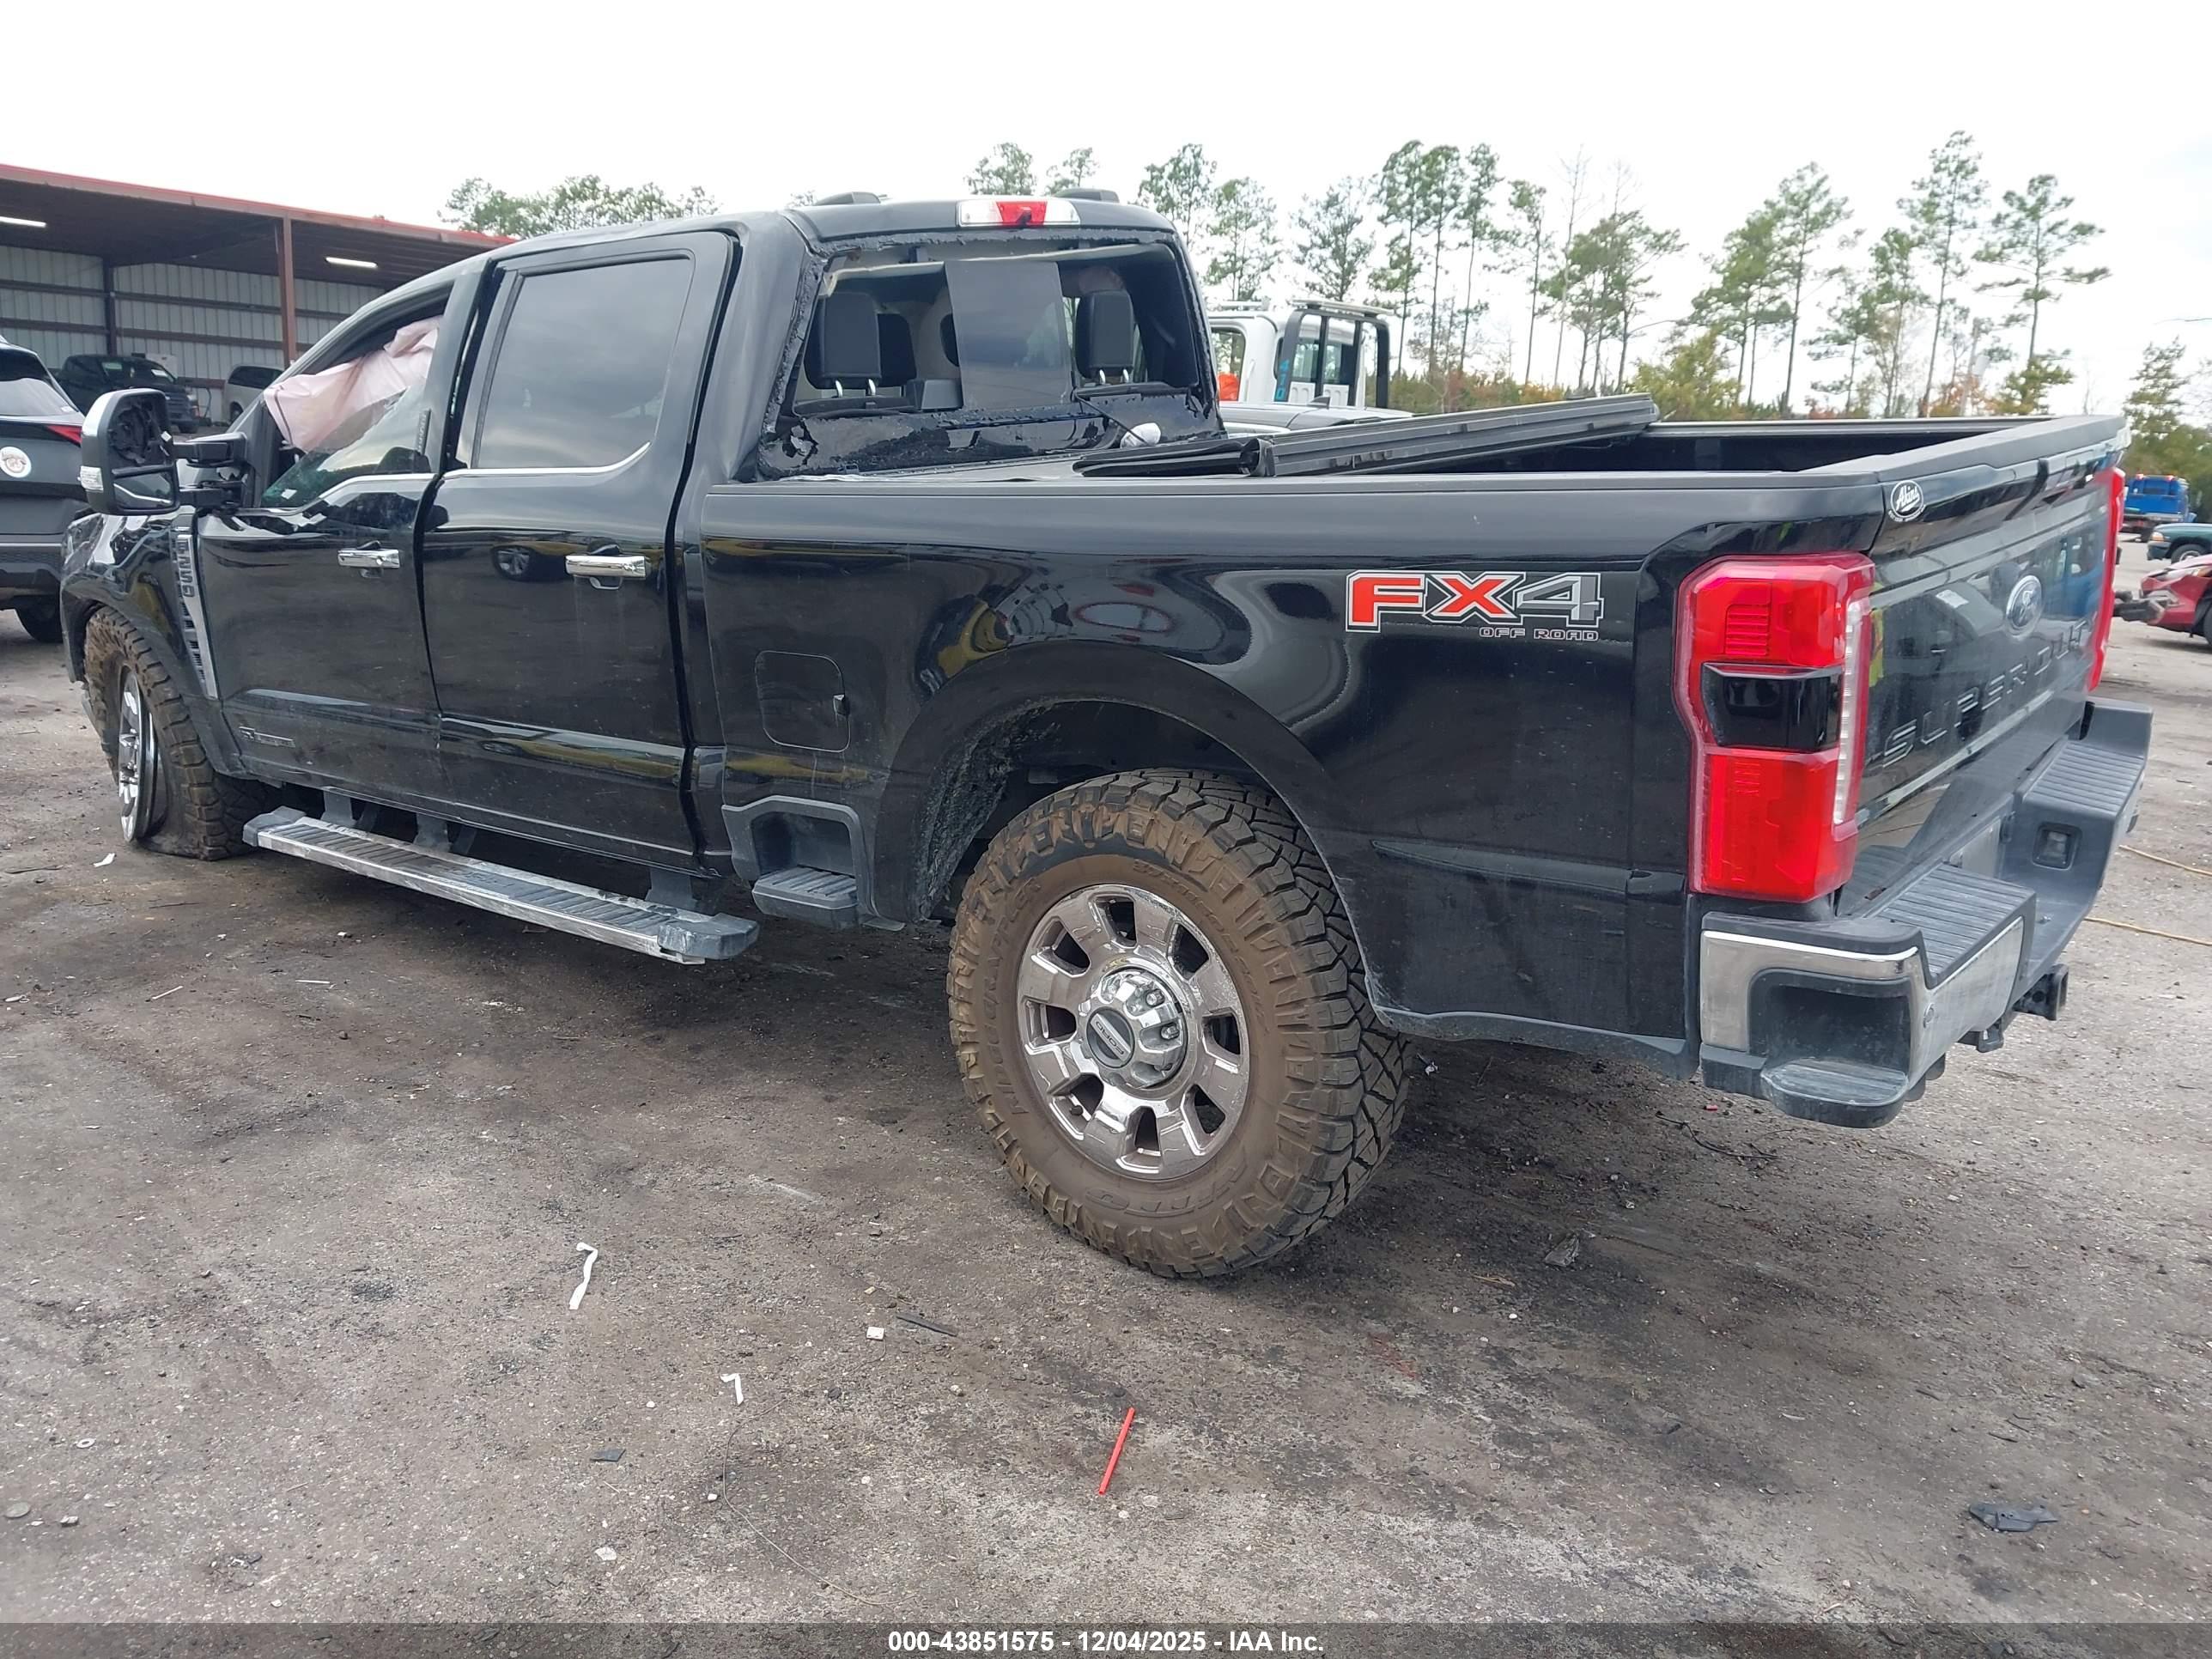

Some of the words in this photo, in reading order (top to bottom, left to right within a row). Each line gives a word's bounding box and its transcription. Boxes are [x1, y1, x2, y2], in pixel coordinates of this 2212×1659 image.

[1275, 359, 1290, 400] 410
[1345, 570, 1604, 633] FX4
[1479, 626, 1526, 640] OFF
[1533, 627, 1599, 641] ROAD
[1882, 662, 2030, 768] SUPER
[1095, 1020, 1125, 1055] FORD
